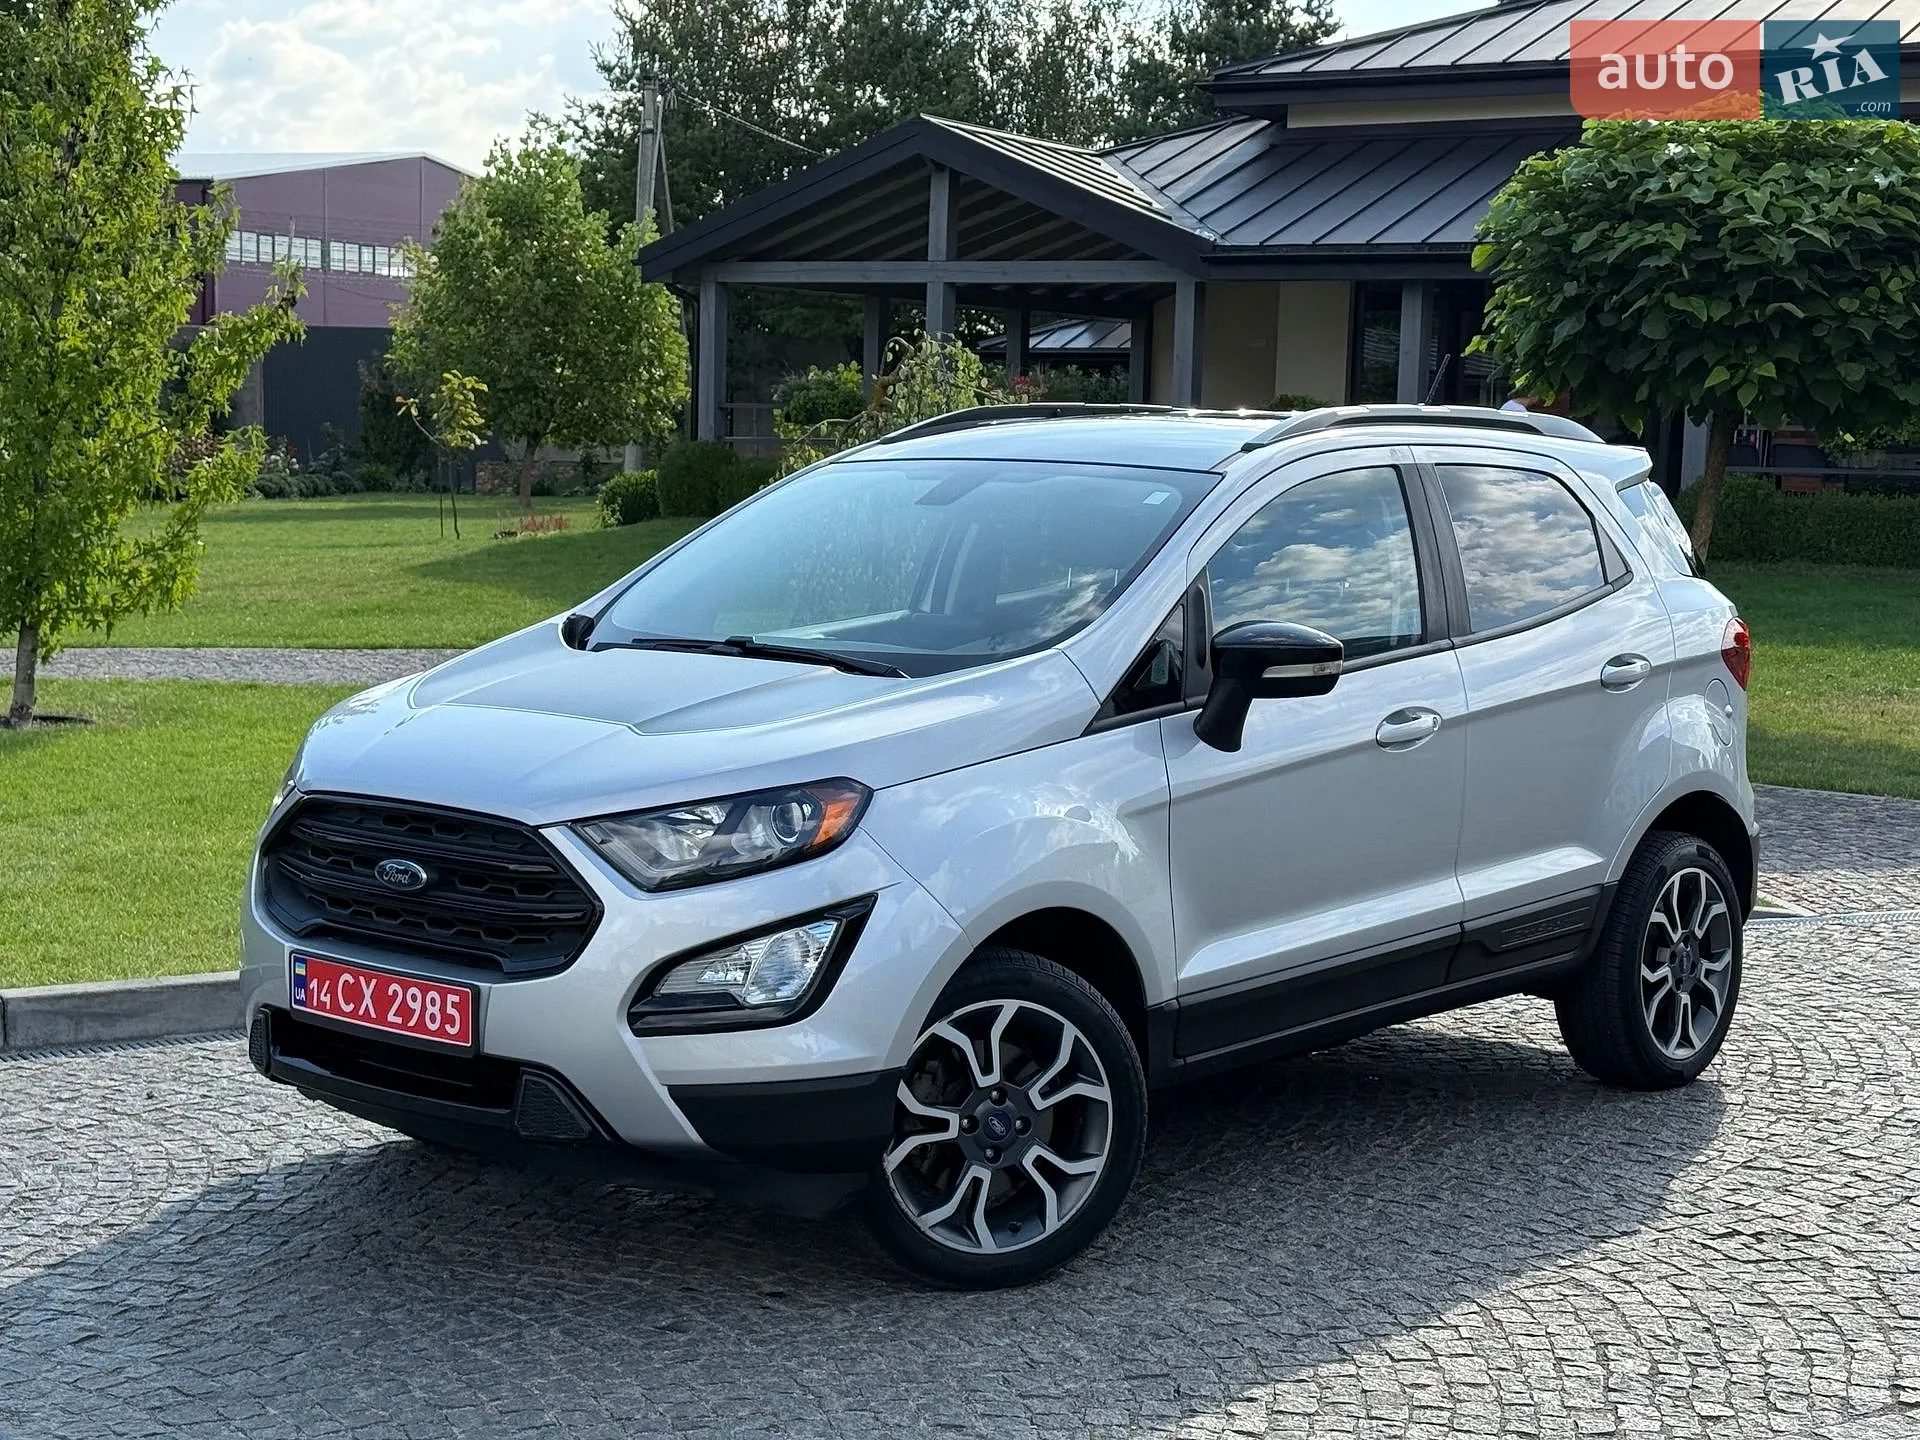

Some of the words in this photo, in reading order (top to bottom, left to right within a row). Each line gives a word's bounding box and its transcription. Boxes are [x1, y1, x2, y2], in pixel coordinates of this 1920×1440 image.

[383, 863, 411, 885] Ford
[295, 986, 306, 1001] UA
[309, 978, 331, 1010] 14
[337, 973, 378, 1019] CX
[387, 983, 461, 1035] 2985
